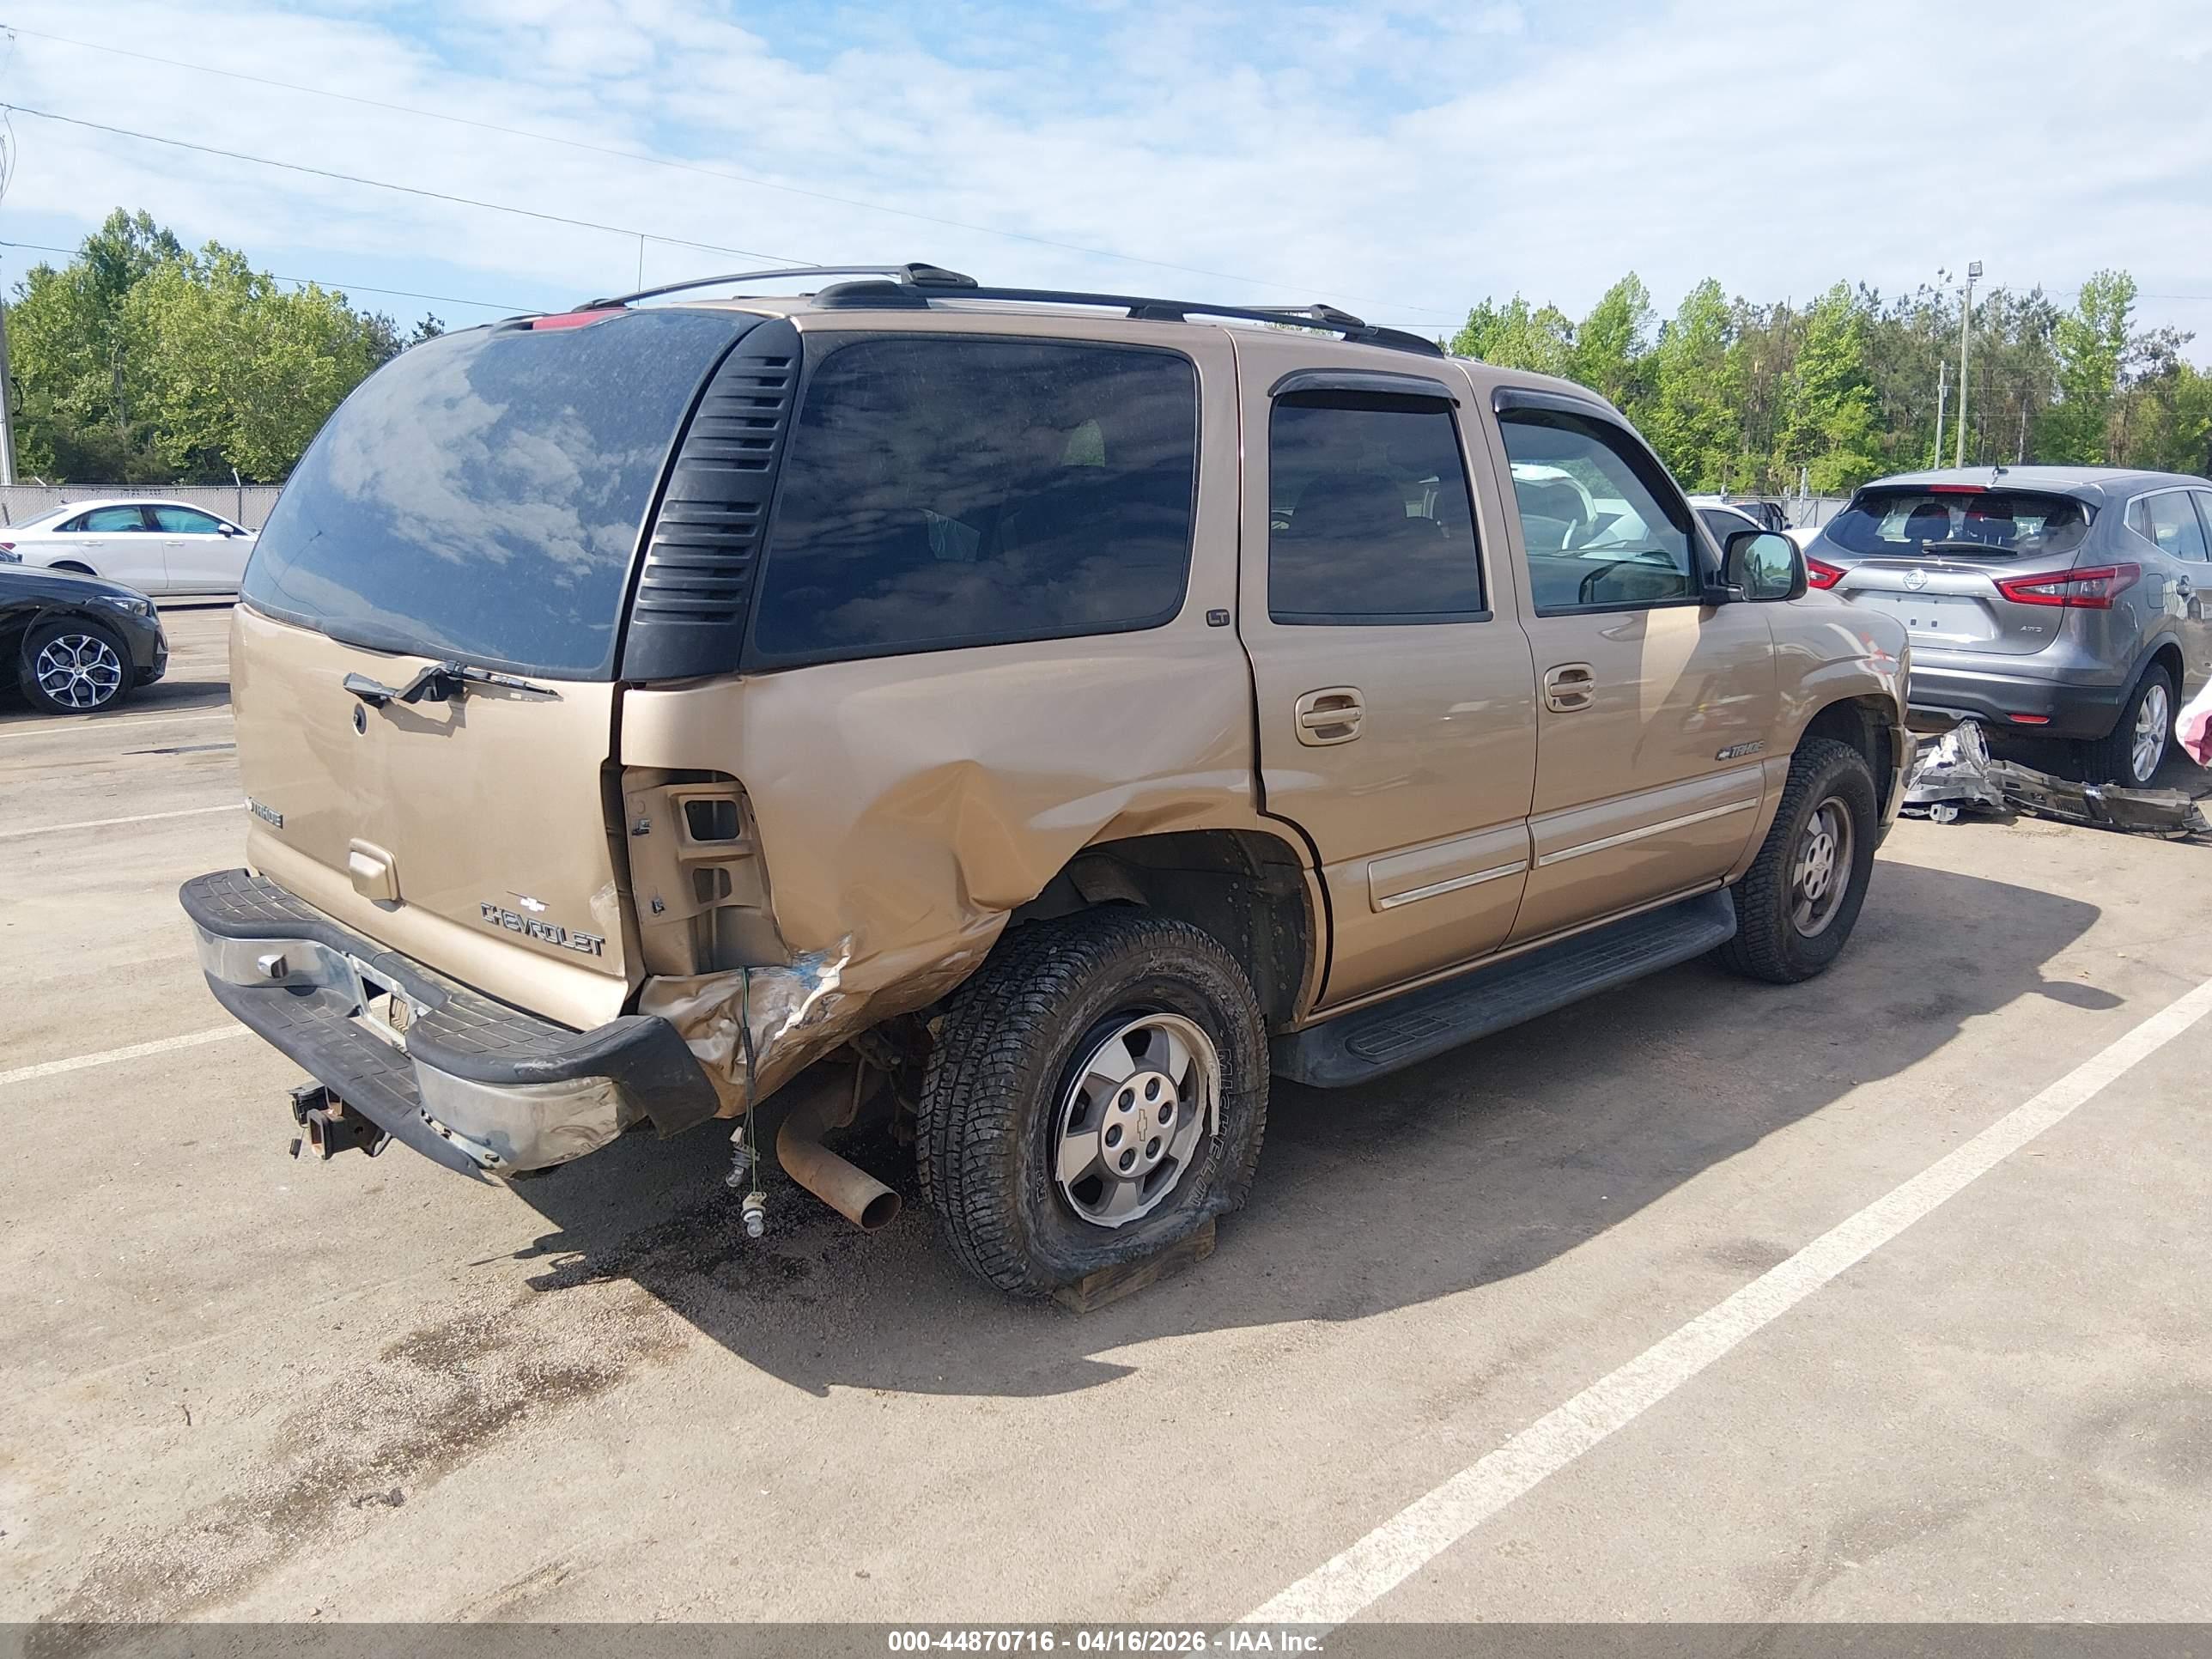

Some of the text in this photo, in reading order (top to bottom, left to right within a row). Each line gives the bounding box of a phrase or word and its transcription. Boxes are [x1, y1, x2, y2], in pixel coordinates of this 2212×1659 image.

[1207, 611, 1228, 624] LT
[1731, 740, 1765, 757] TAHOE
[481, 902, 605, 957] CHEVROLET
[1188, 1048, 1233, 1206] MICHELIN
